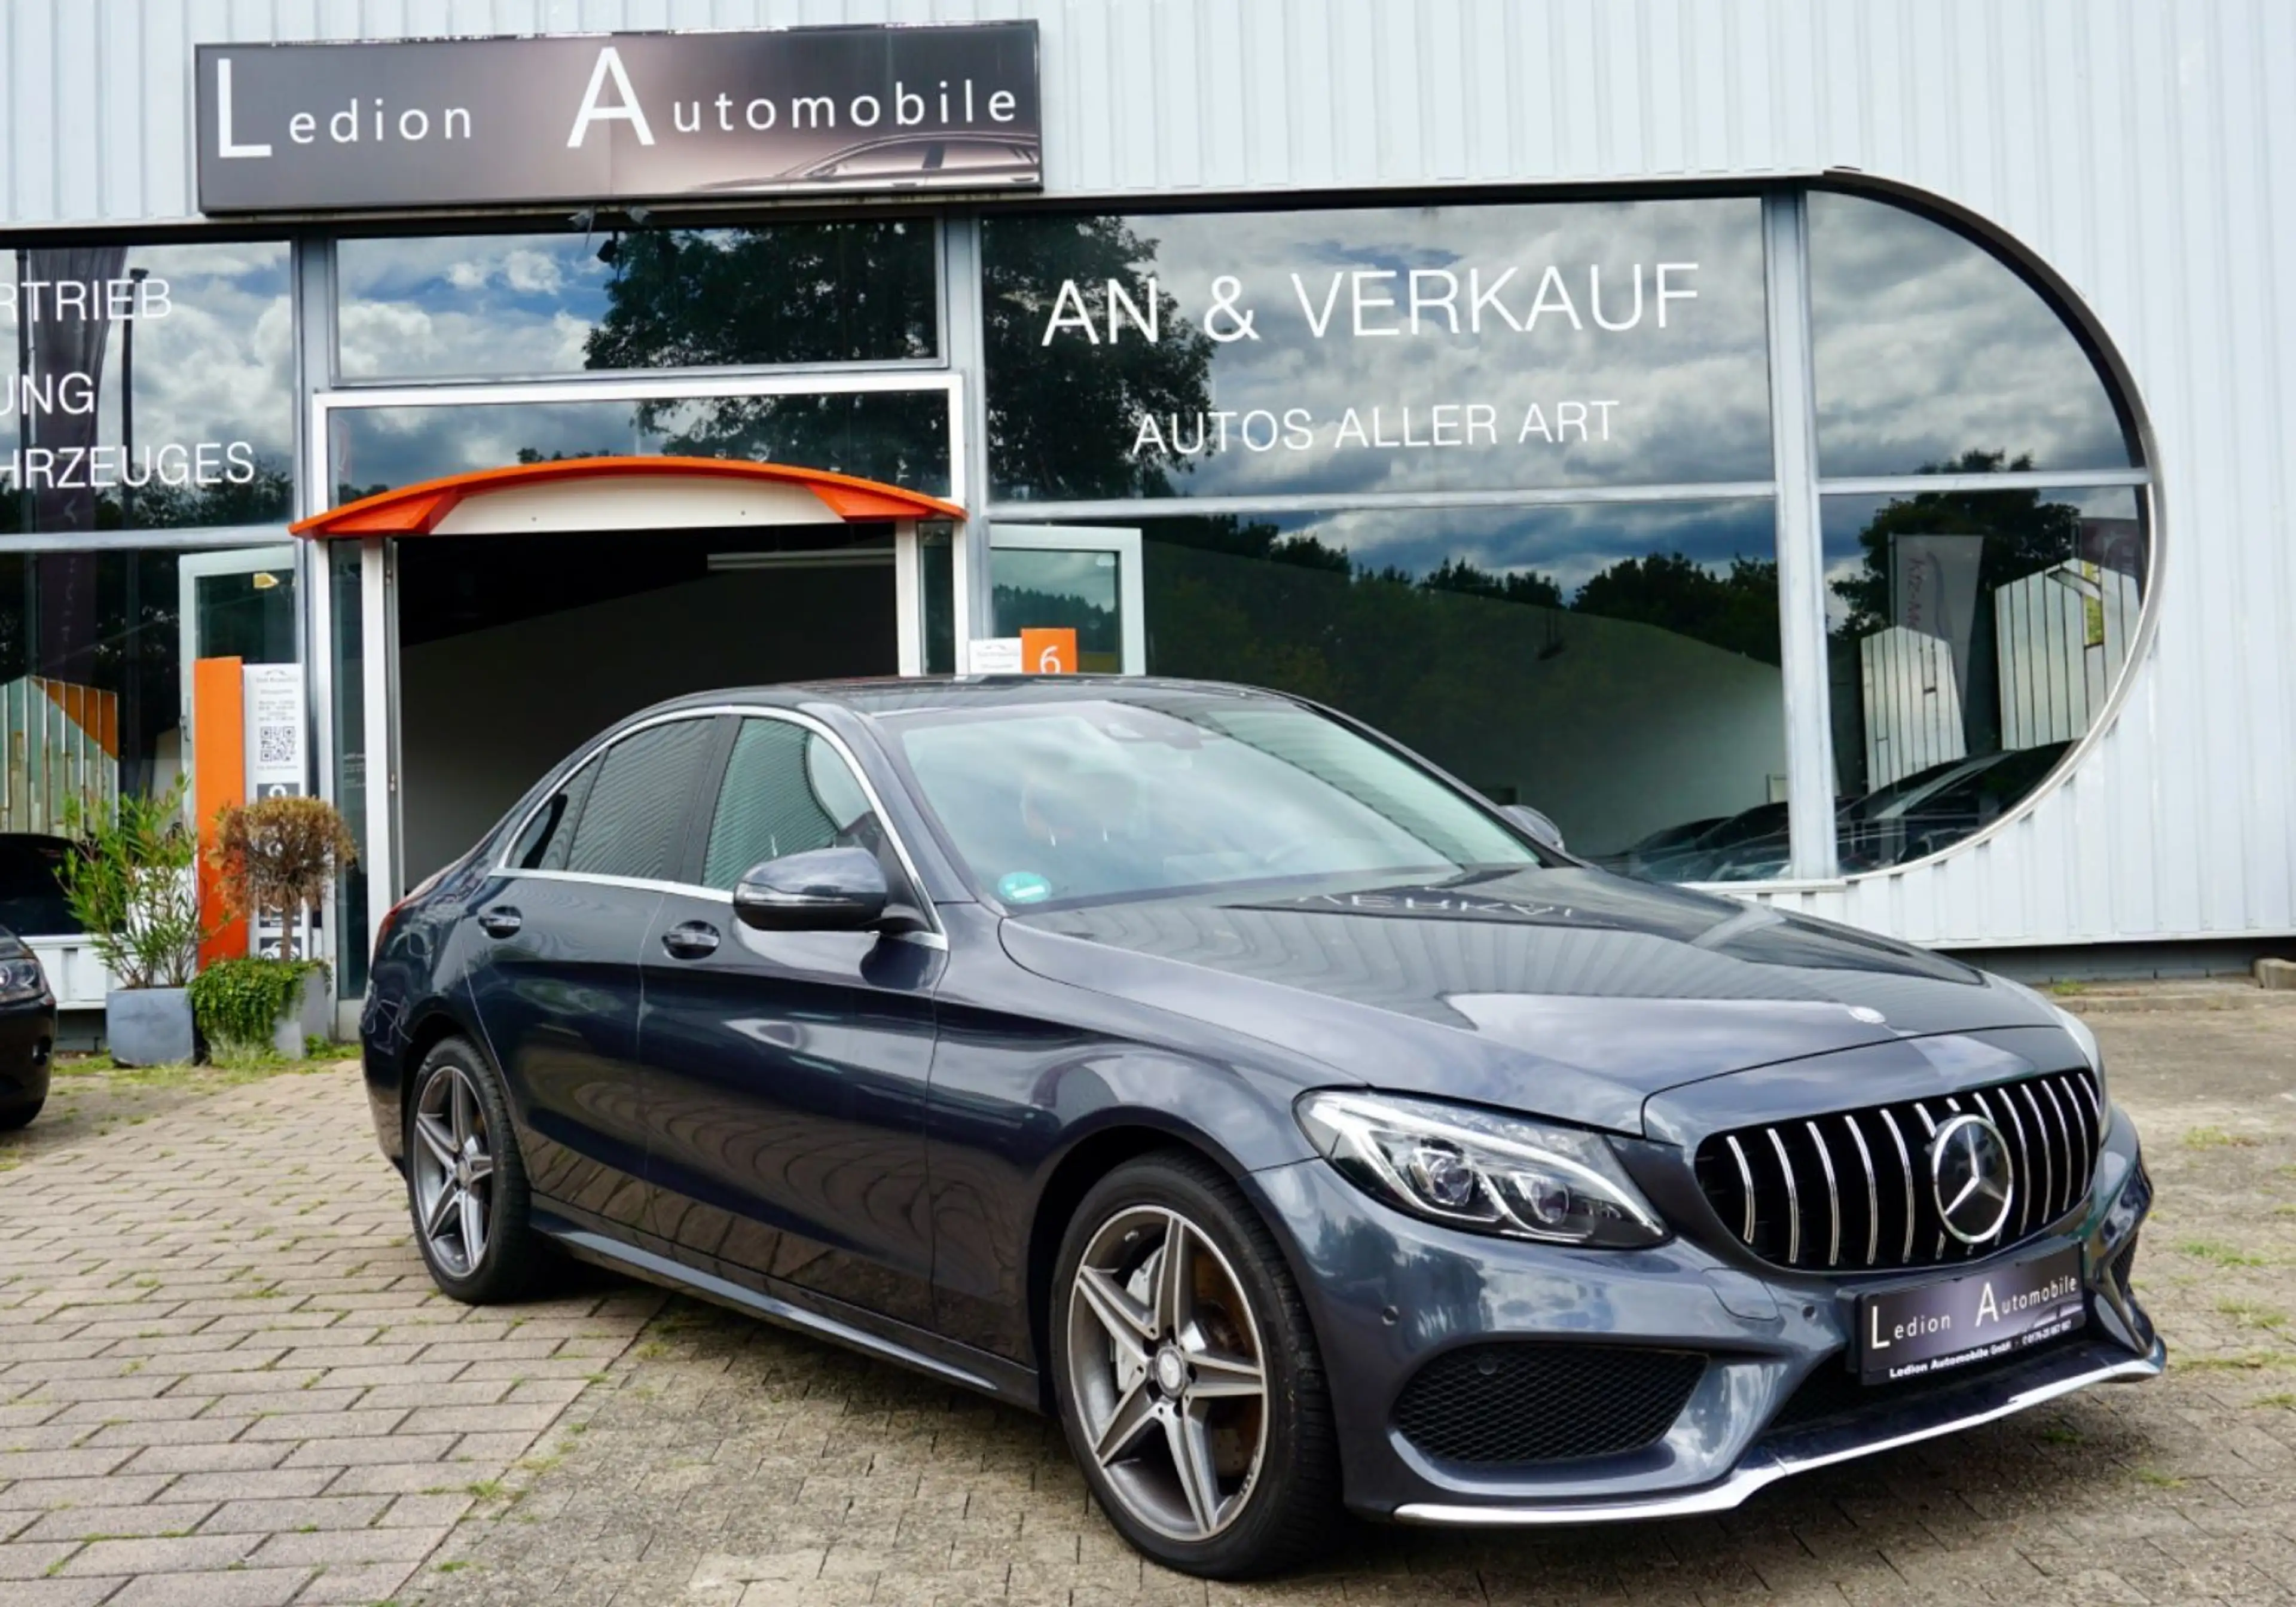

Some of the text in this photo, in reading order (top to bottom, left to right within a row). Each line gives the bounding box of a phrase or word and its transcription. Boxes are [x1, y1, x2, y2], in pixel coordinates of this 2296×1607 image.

[218, 46, 1017, 158] Ledion Automobile
[1042, 262, 1699, 346] AN & VERKAUF
[1132, 400, 1620, 455] AUTOS ALLER ART
[1040, 645, 1062, 674] 6
[1871, 1274, 2077, 1350] Ledion Automobile
[1889, 1362, 1928, 1379] Ledion
[1930, 1348, 1989, 1370] Automobile
